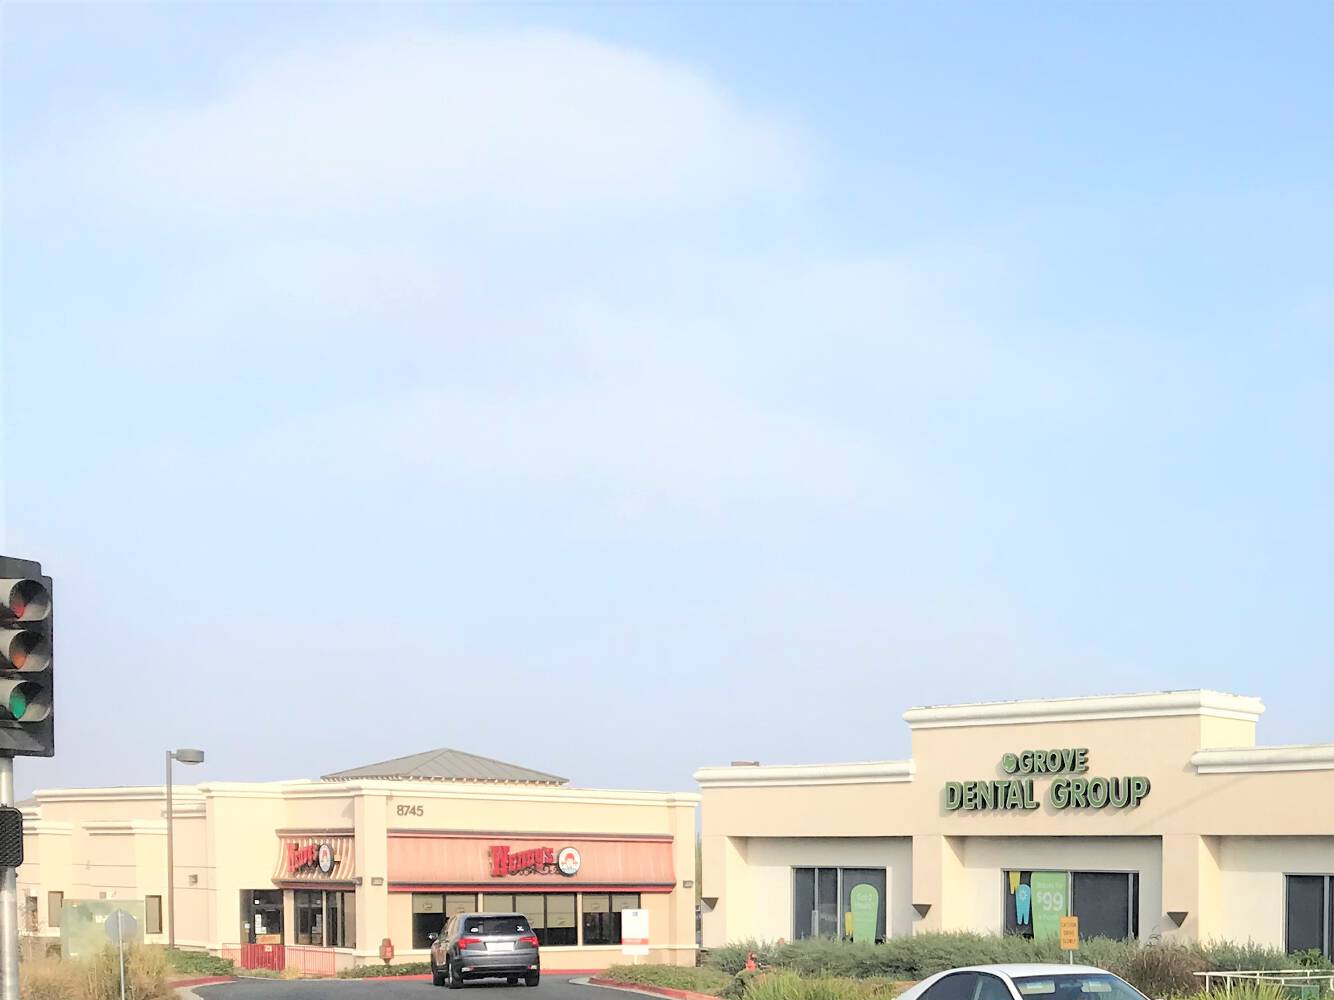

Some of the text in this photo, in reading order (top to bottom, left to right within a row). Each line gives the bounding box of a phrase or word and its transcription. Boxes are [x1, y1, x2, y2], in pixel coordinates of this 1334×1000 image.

[1018, 748, 1089, 774] GROVE
[944, 776, 1151, 811] DENTAL GROUP
[396, 804, 424, 817] 8745
[1036, 890, 1064, 912] $99
